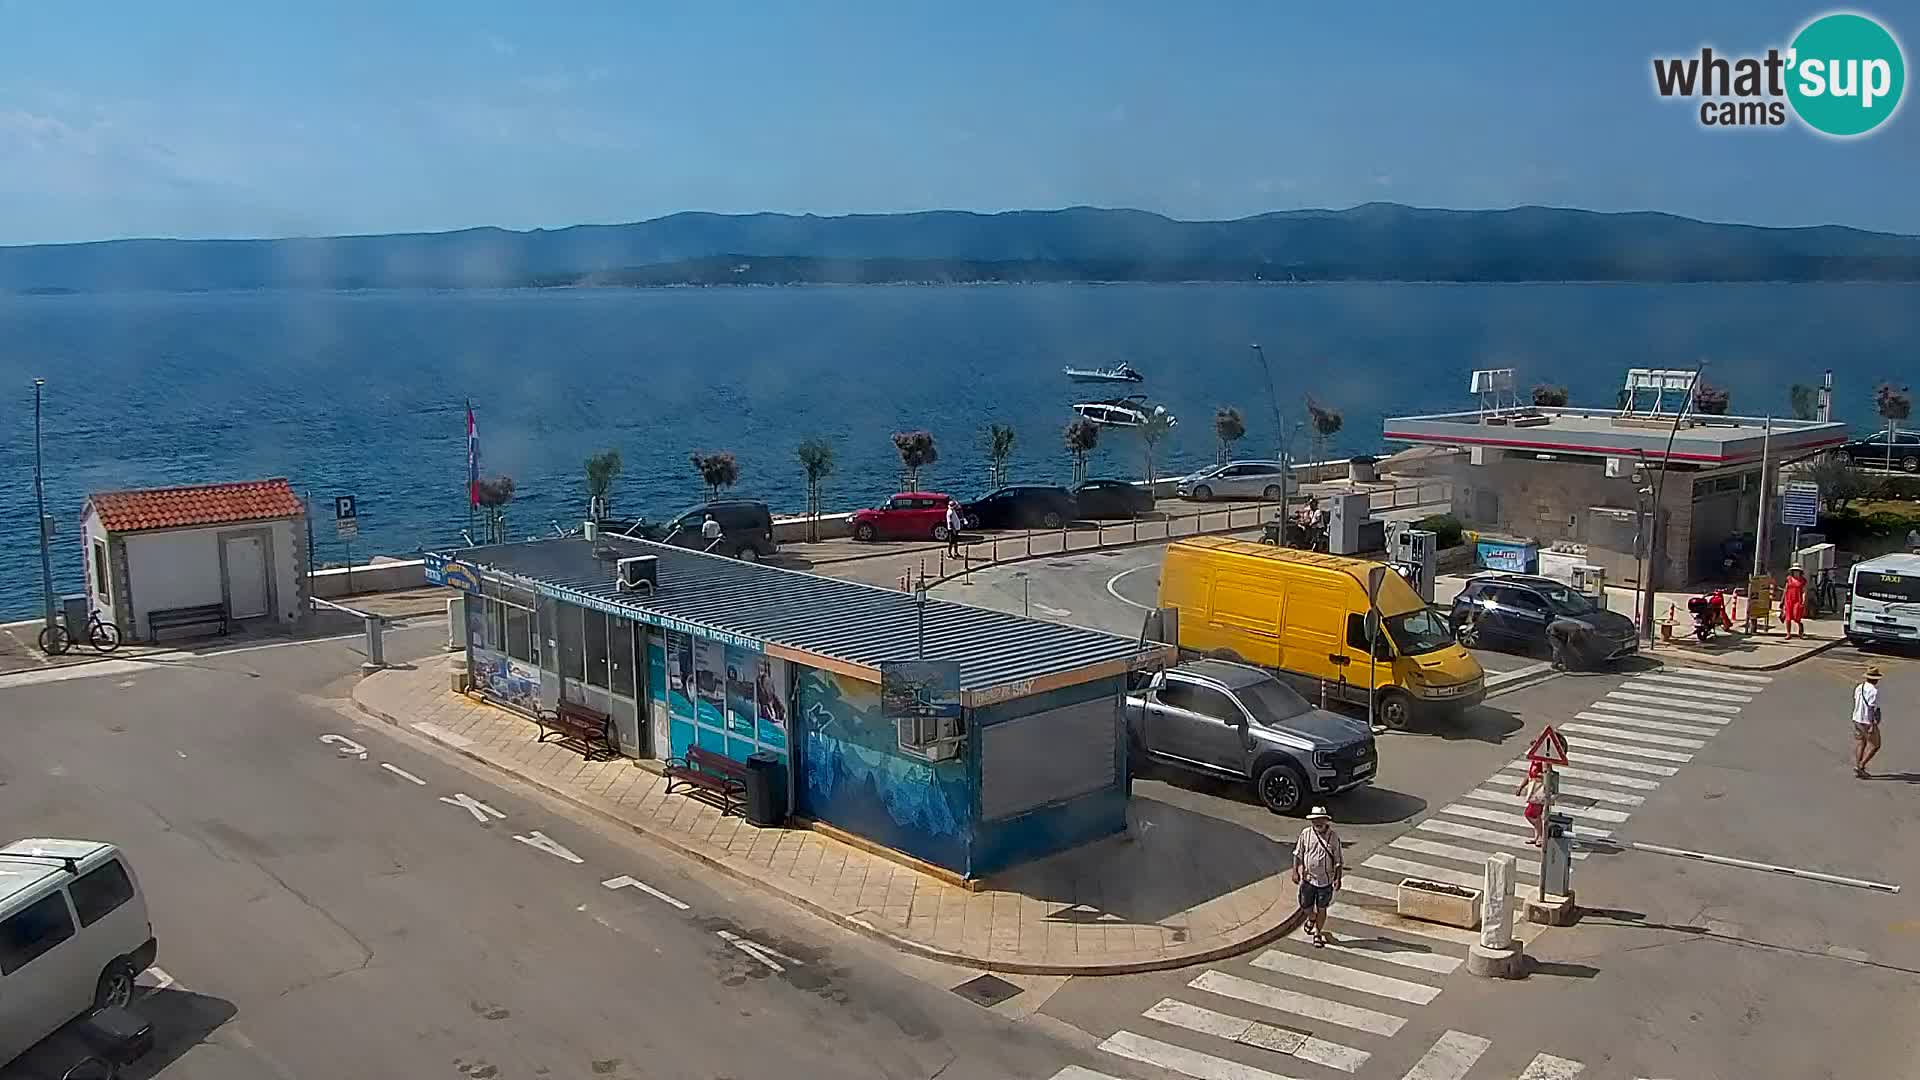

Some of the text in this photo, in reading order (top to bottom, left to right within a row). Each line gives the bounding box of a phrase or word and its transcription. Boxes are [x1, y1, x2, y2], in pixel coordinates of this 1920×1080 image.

[340, 499, 352, 516] P
[1880, 574, 1901, 584] TAXI
[622, 608, 651, 623] POSTAJA
[660, 617, 675, 629] BUS
[676, 622, 706, 637] STATION
[709, 629, 734, 644] TICKET
[735, 636, 760, 650] OFFICE
